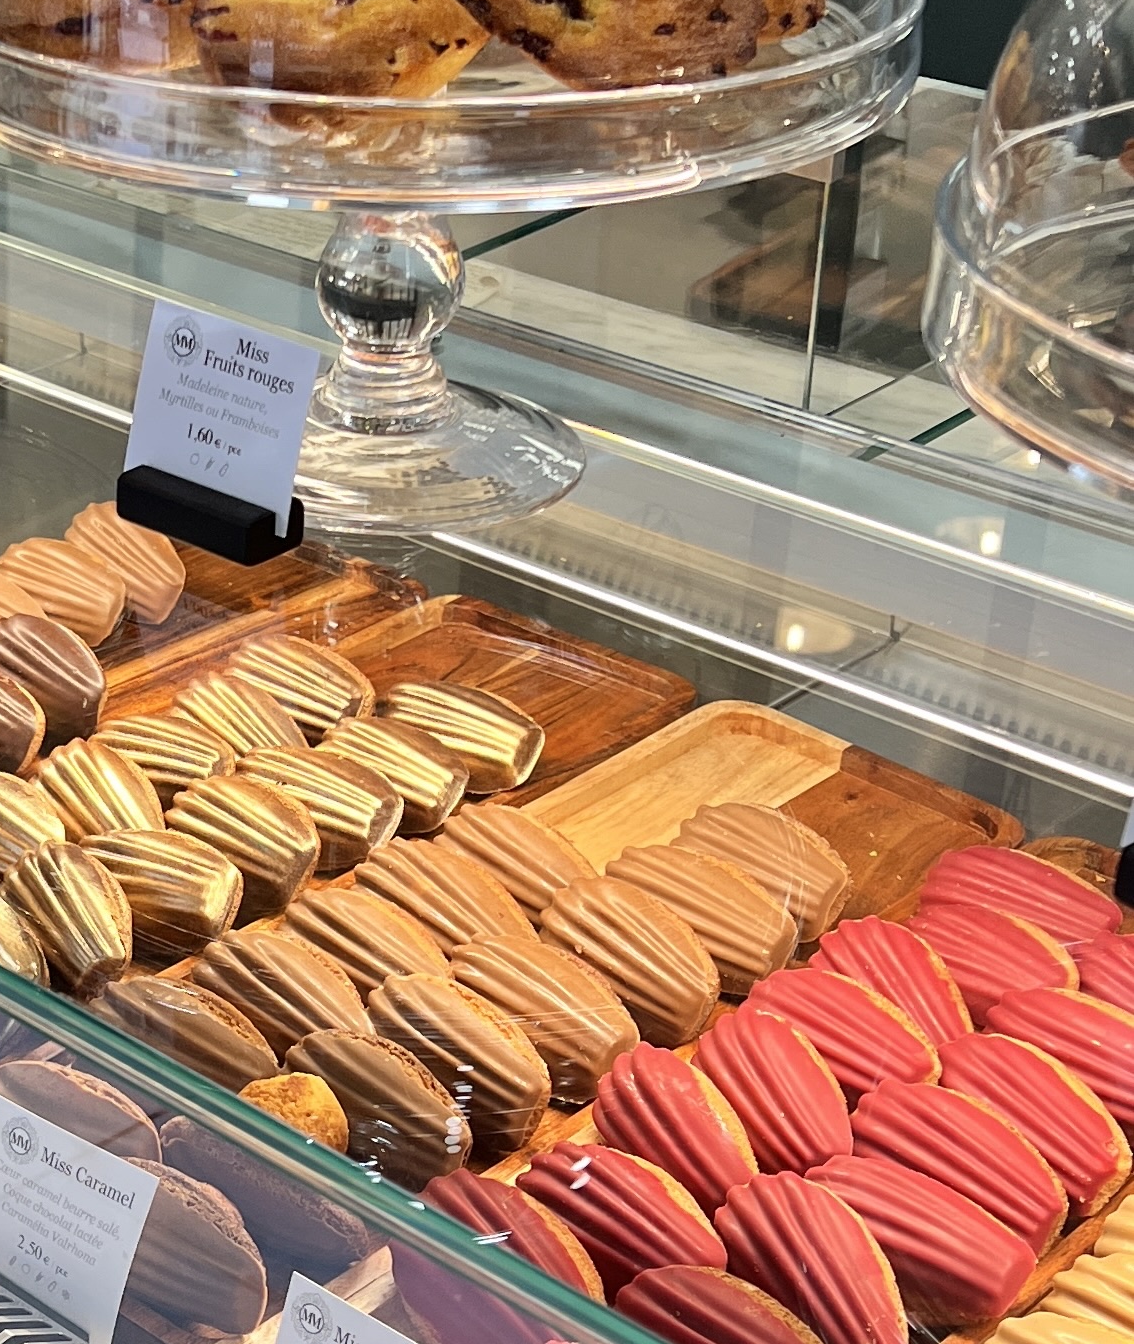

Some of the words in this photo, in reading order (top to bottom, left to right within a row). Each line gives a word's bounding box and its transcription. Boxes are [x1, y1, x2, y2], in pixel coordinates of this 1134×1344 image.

[203, 348, 244, 377] Fruits
[247, 367, 294, 394] rouges
[235, 337, 269, 363] Miss
[158, 387, 203, 412] Myrtilles
[205, 406, 219, 417] ou
[220, 408, 279, 439] Framboises
[176, 372, 229, 400] Madeleine
[230, 393, 267, 416] nature,
[187, 422, 213, 444] 1,60
[227, 445, 241, 456] pce
[40, 1146, 72, 1176] Miss
[75, 1166, 135, 1209] Caramel
[2, 1182, 31, 1208] Coque
[32, 1201, 73, 1232] chocolat
[73, 1223, 103, 1249] lactée
[21, 1177, 62, 1205] caramel
[61, 1196, 96, 1224] beurre
[96, 1219, 120, 1240] salé,
[16, 1233, 42, 1260] 2,50
[52, 1230, 96, 1266] Valrhona
